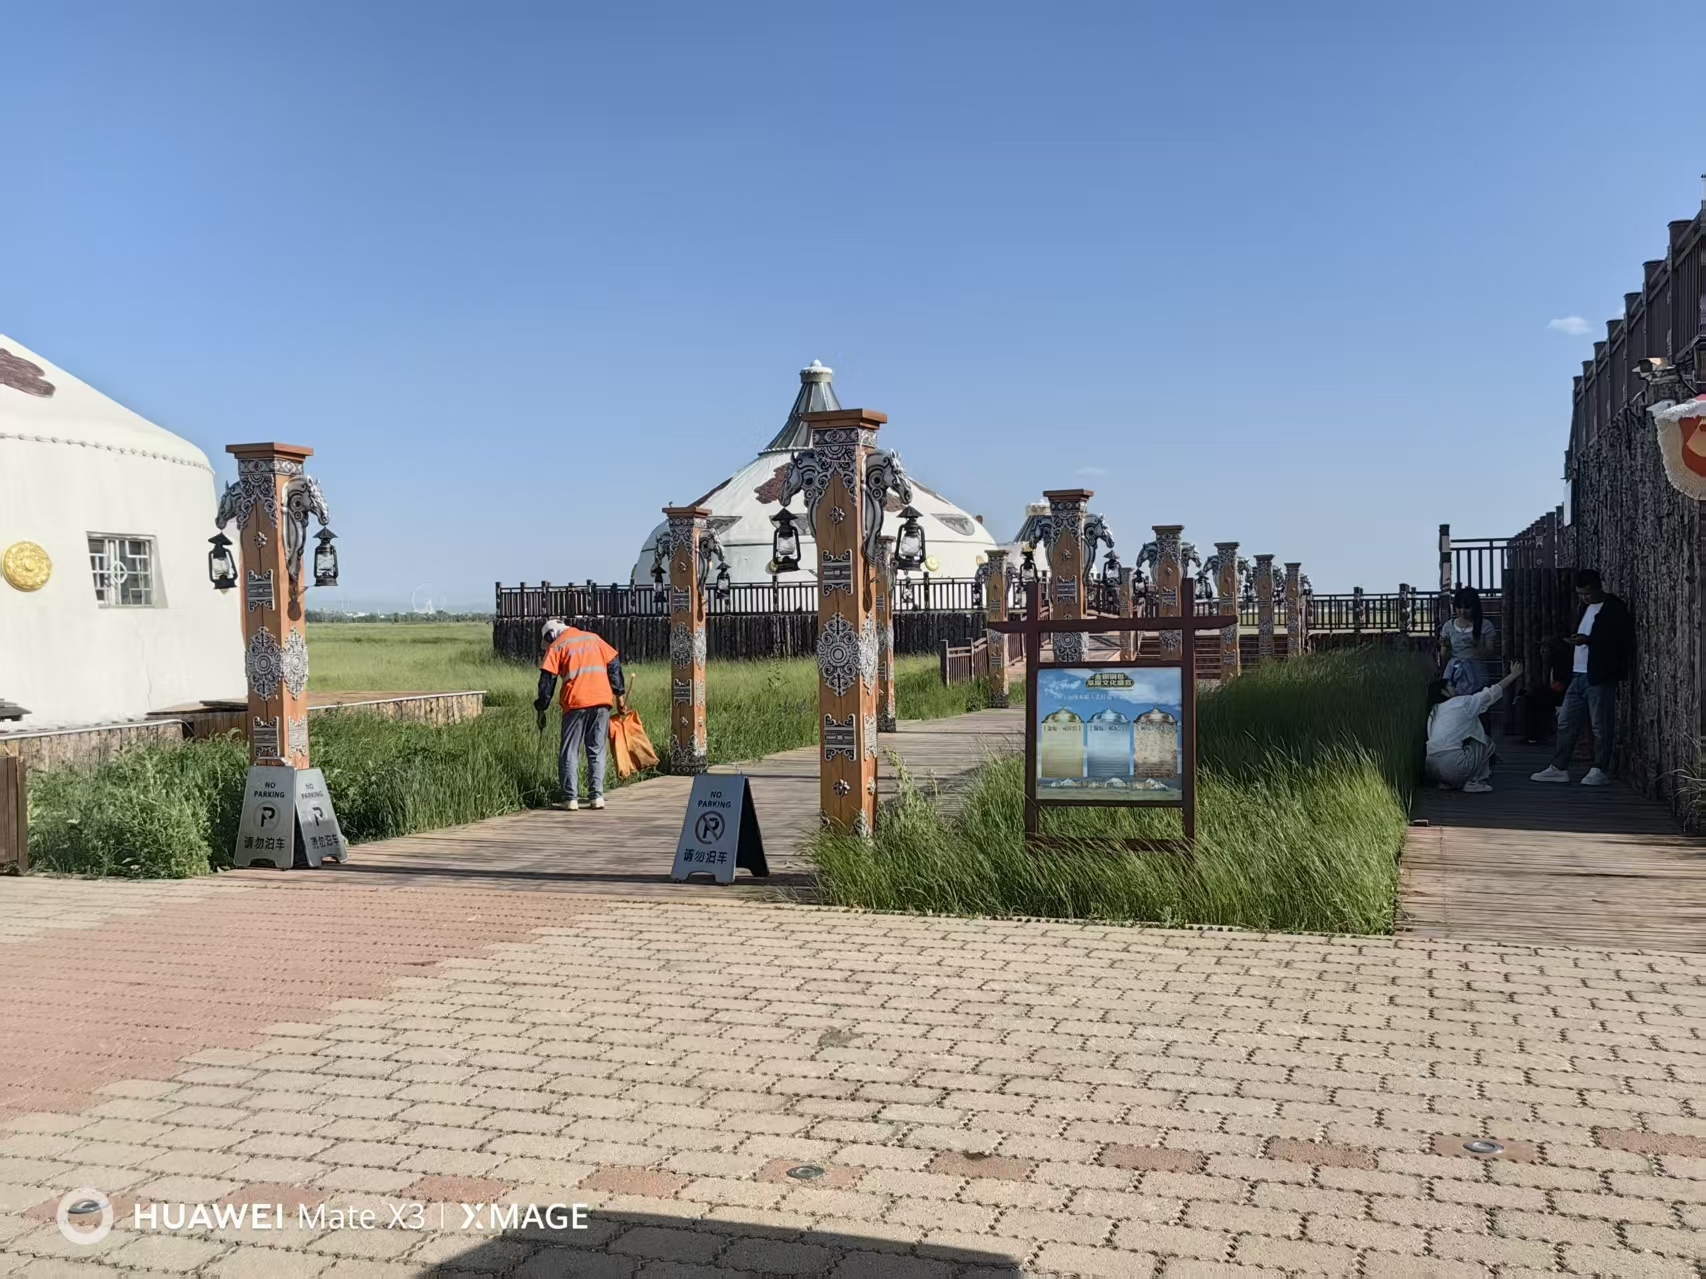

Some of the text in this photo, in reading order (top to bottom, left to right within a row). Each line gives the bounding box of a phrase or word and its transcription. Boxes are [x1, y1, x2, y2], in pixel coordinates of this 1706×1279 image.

[264, 781, 276, 789] NO
[253, 790, 285, 799] PARKING
[301, 790, 324, 800] PARKING
[710, 791, 722, 799] NO
[697, 800, 732, 809] PARKING
[243, 835, 286, 852] 请勿泊车
[310, 833, 340, 850] 请勿泊车
[683, 848, 729, 865] 请勿泊车
